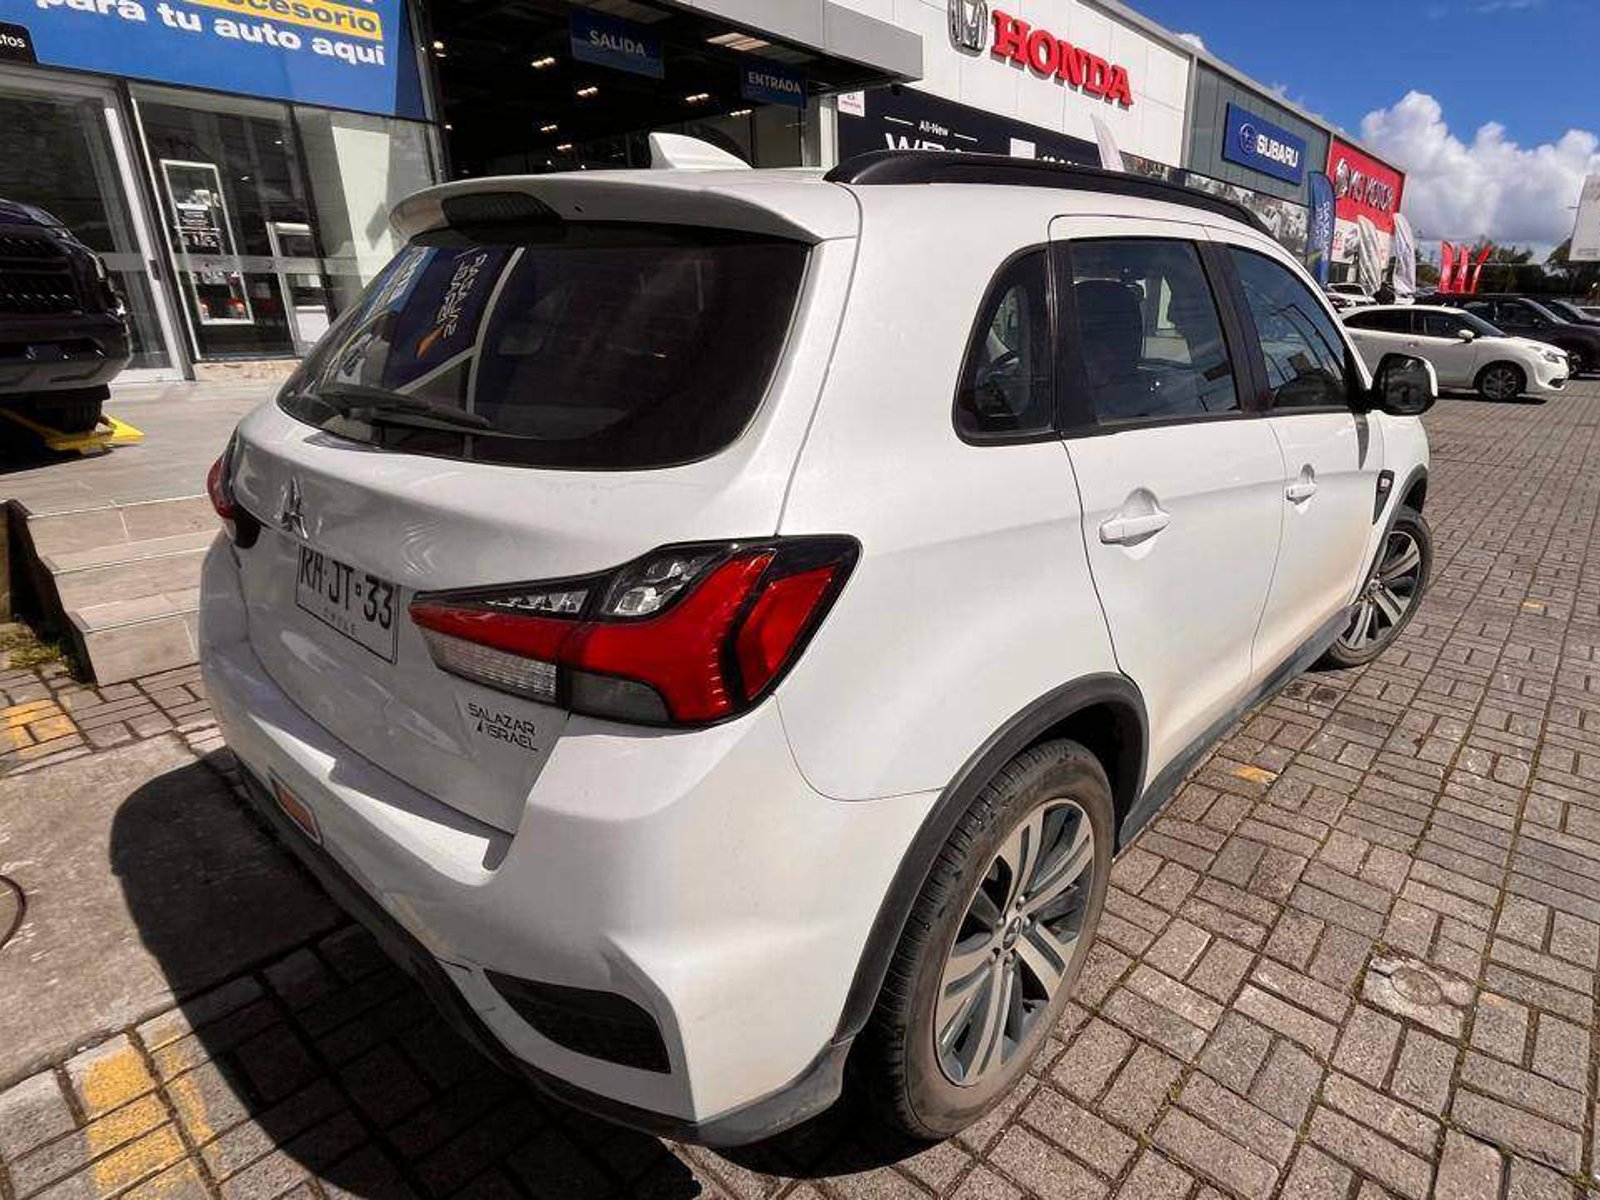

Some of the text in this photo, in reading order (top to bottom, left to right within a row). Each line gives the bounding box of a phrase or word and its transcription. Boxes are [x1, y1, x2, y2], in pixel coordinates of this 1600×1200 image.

[0, 33, 26, 48] tos
[157, 3, 202, 32] tu
[214, 18, 301, 50] auto
[589, 29, 646, 57] SALIDA
[991, 9, 1134, 110] HONDA
[748, 71, 802, 95] ENTRADA
[919, 120, 949, 137] All-New
[1256, 134, 1299, 168] SUBARU
[468, 702, 535, 736] SALAZAR
